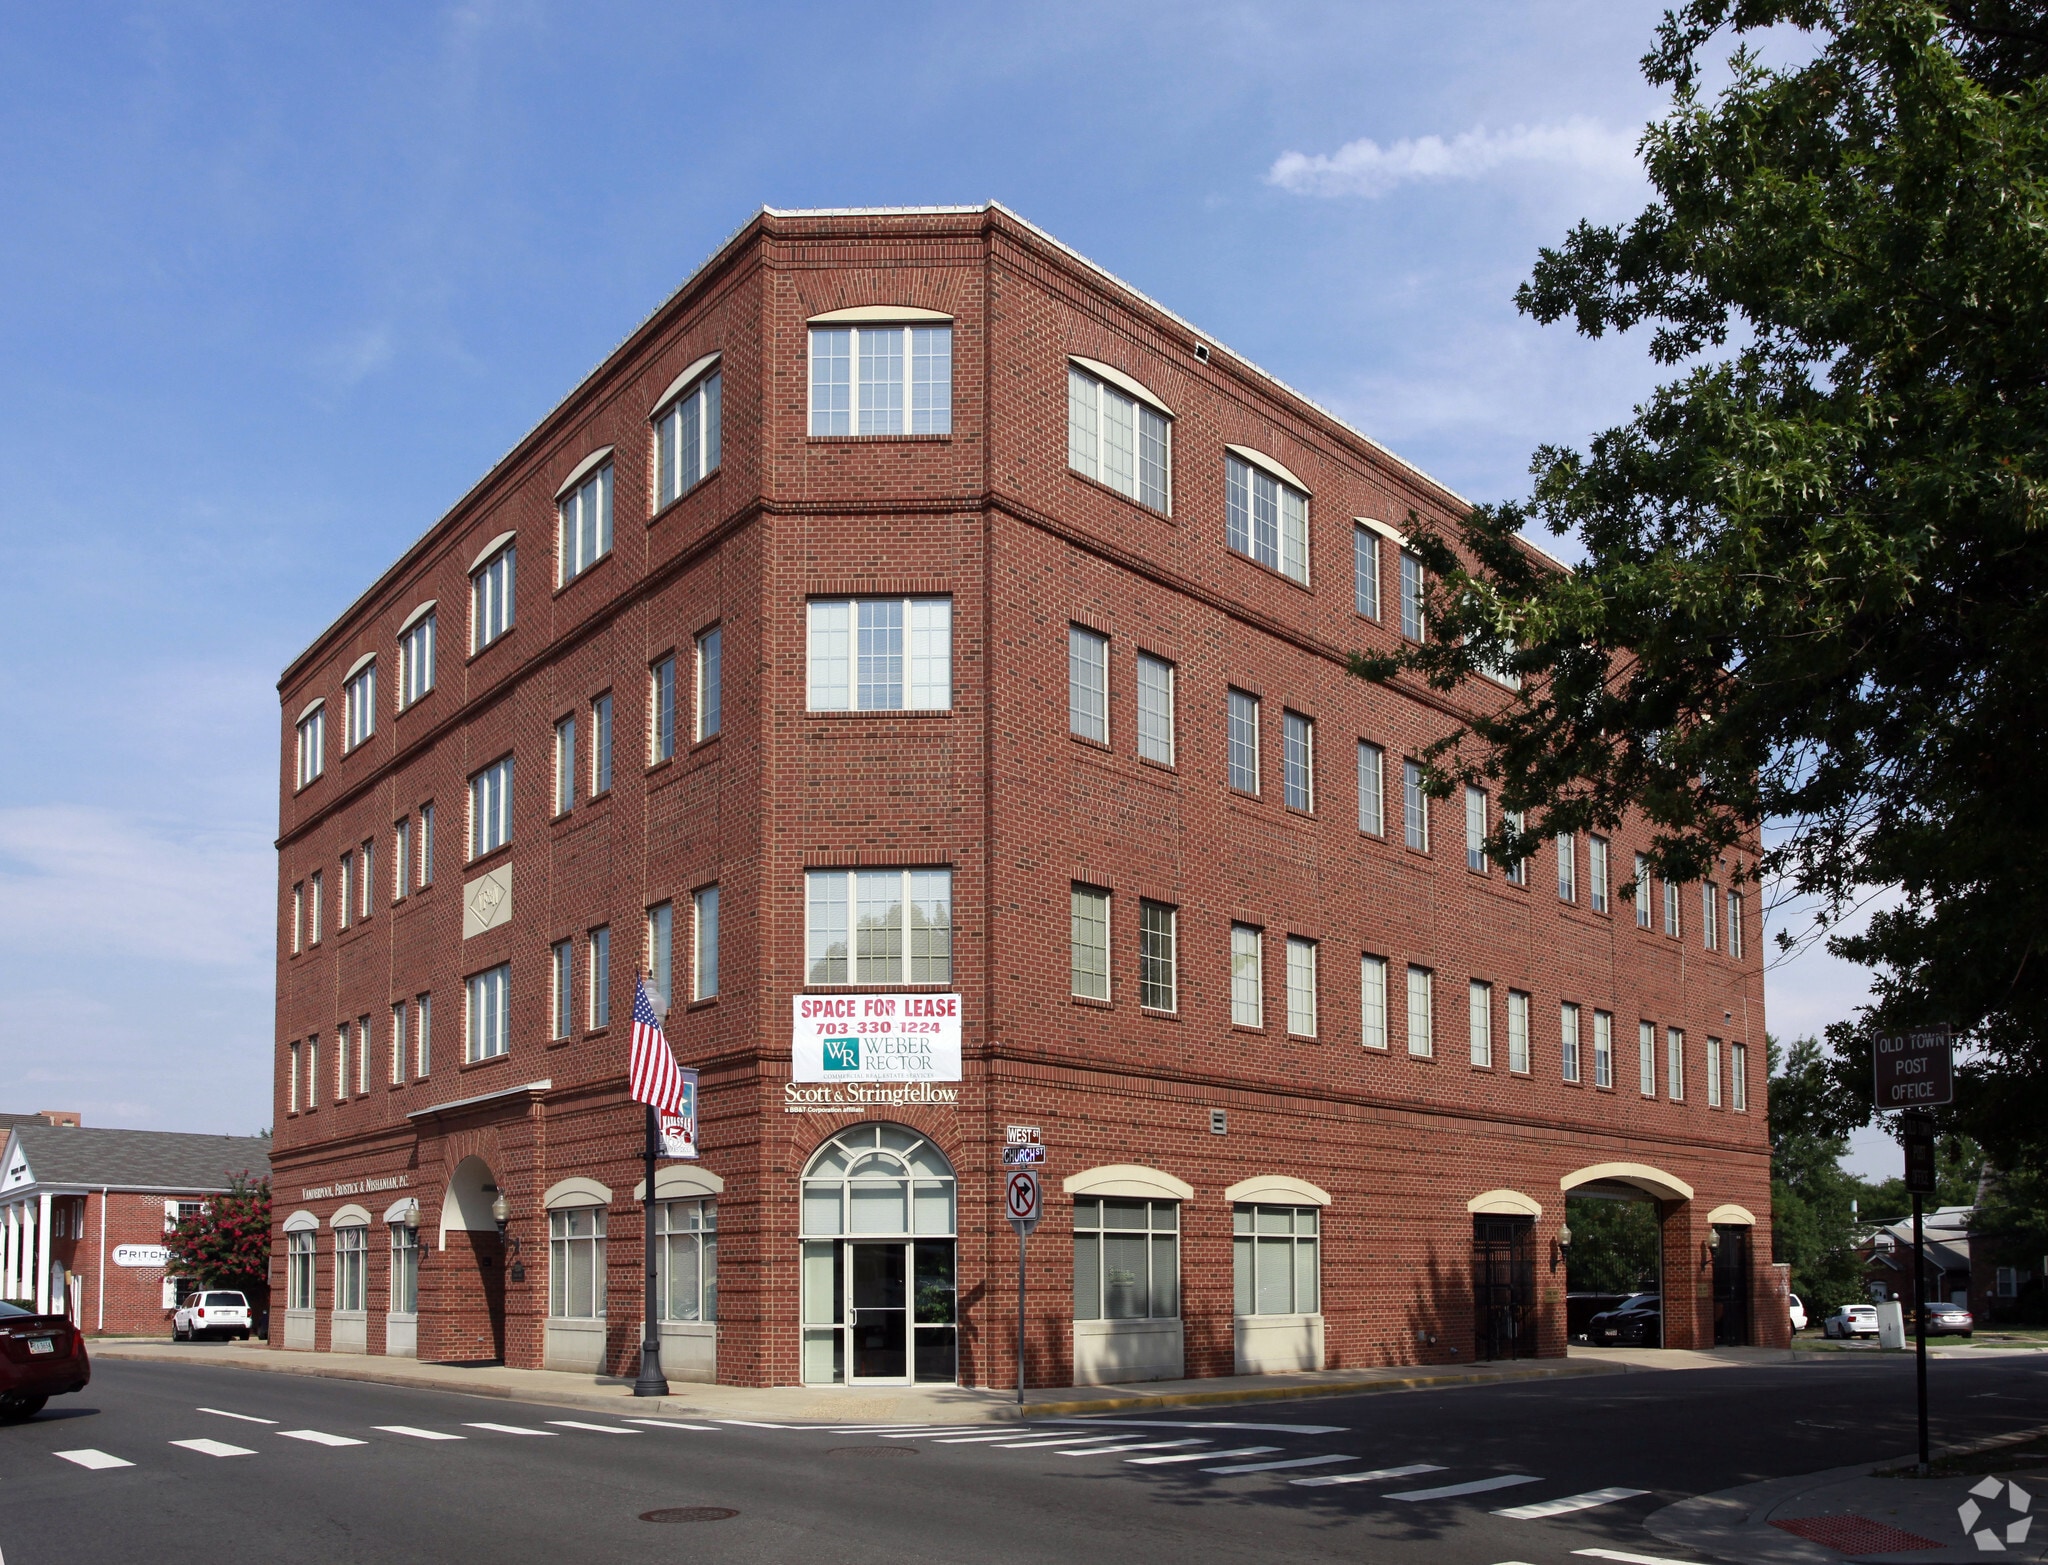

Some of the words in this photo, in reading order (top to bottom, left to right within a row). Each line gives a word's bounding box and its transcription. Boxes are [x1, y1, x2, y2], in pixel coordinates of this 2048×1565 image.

[801, 999, 856, 1018] SPACE
[864, 998, 896, 1017] FOR
[904, 998, 957, 1017] LEASE
[816, 1021, 941, 1035] 703-330-1224
[864, 1037, 933, 1054] WEBER
[1879, 1036, 1904, 1053] OLD
[1910, 1032, 1945, 1050] TOWN
[865, 1055, 933, 1070] RECTOR
[1895, 1057, 1928, 1076] POST
[784, 1082, 831, 1102] Scott
[834, 1091, 843, 1102] &
[847, 1080, 959, 1107] Stringfellow
[1891, 1081, 1935, 1100] OFFICE
[807, 1106, 842, 1114] Corporation
[1008, 1128, 1032, 1143] WEST
[1032, 1130, 1039, 1138] ST
[1004, 1148, 1035, 1163] CHURCH
[1035, 1147, 1044, 1155] ST
[359, 1181, 365, 1192] &
